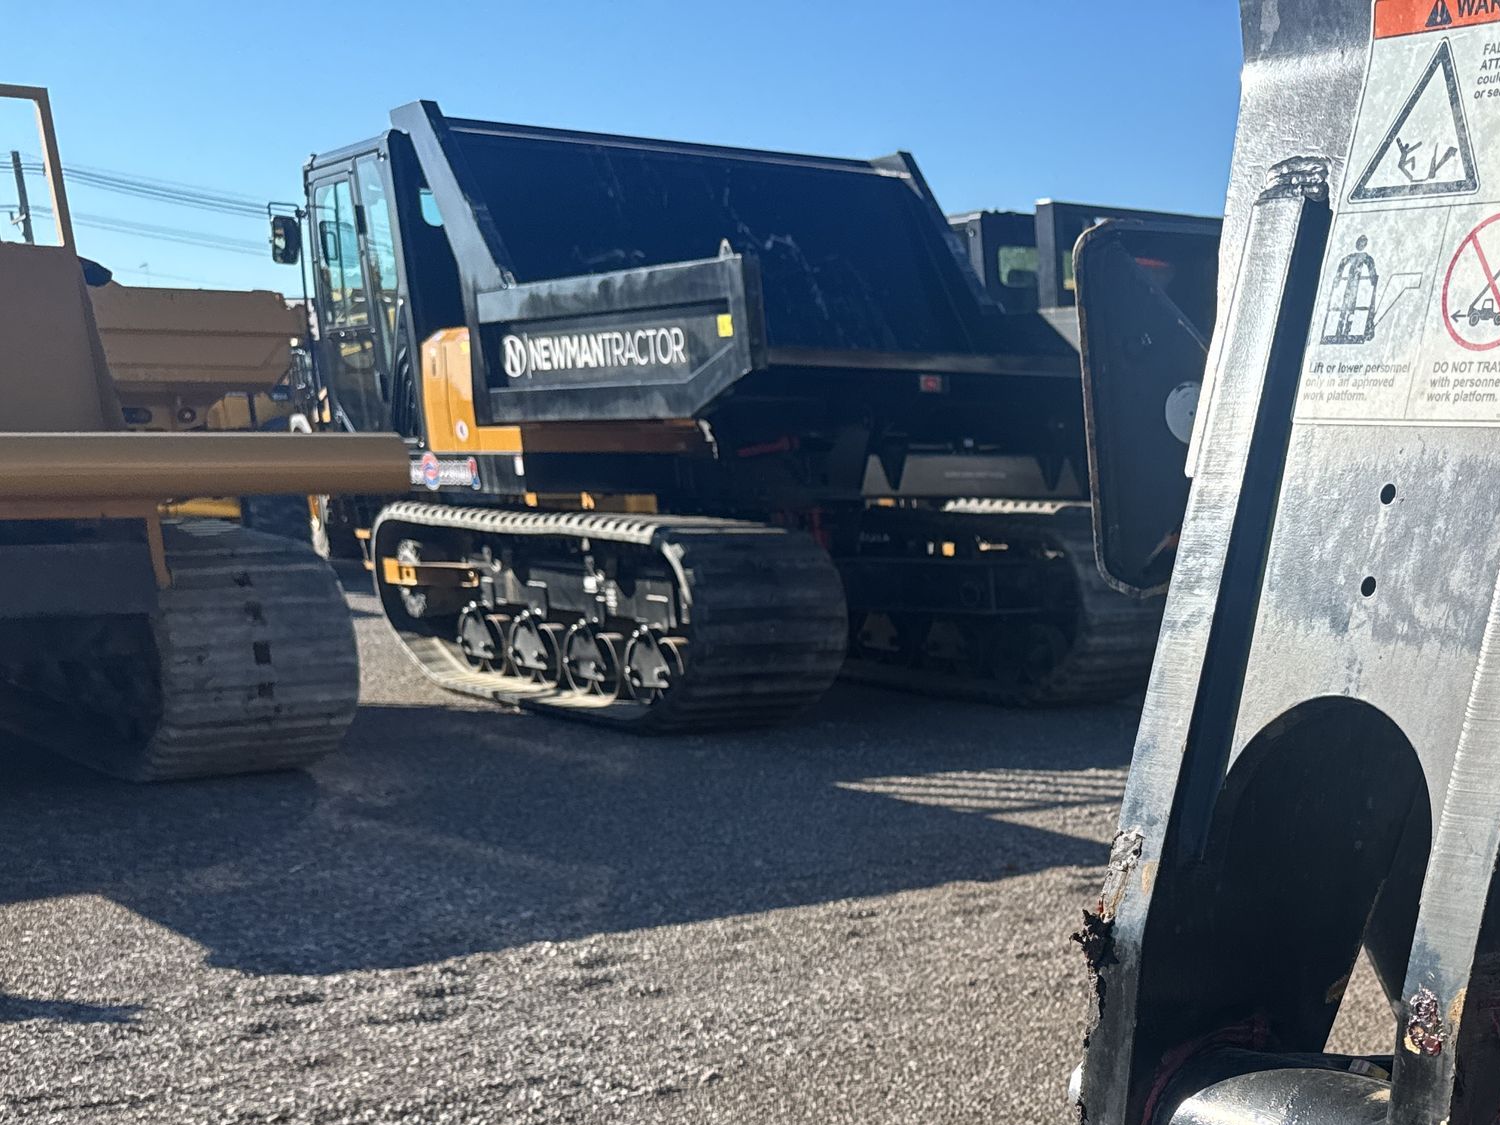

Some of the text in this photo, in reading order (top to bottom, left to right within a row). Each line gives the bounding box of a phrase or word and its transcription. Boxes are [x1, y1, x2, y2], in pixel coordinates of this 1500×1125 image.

[1474, 89, 1486, 99] or
[528, 326, 687, 372] NEWMANTRACTOR
[1308, 362, 1411, 375] Lift or lower personnel
[1433, 361, 1449, 373] DO
[1451, 361, 1474, 373] NOT
[1305, 377, 1395, 389] only in an approved
[1430, 376, 1450, 388] with
[1303, 390, 1368, 403] work platform.
[1427, 390, 1498, 404] work platform.
